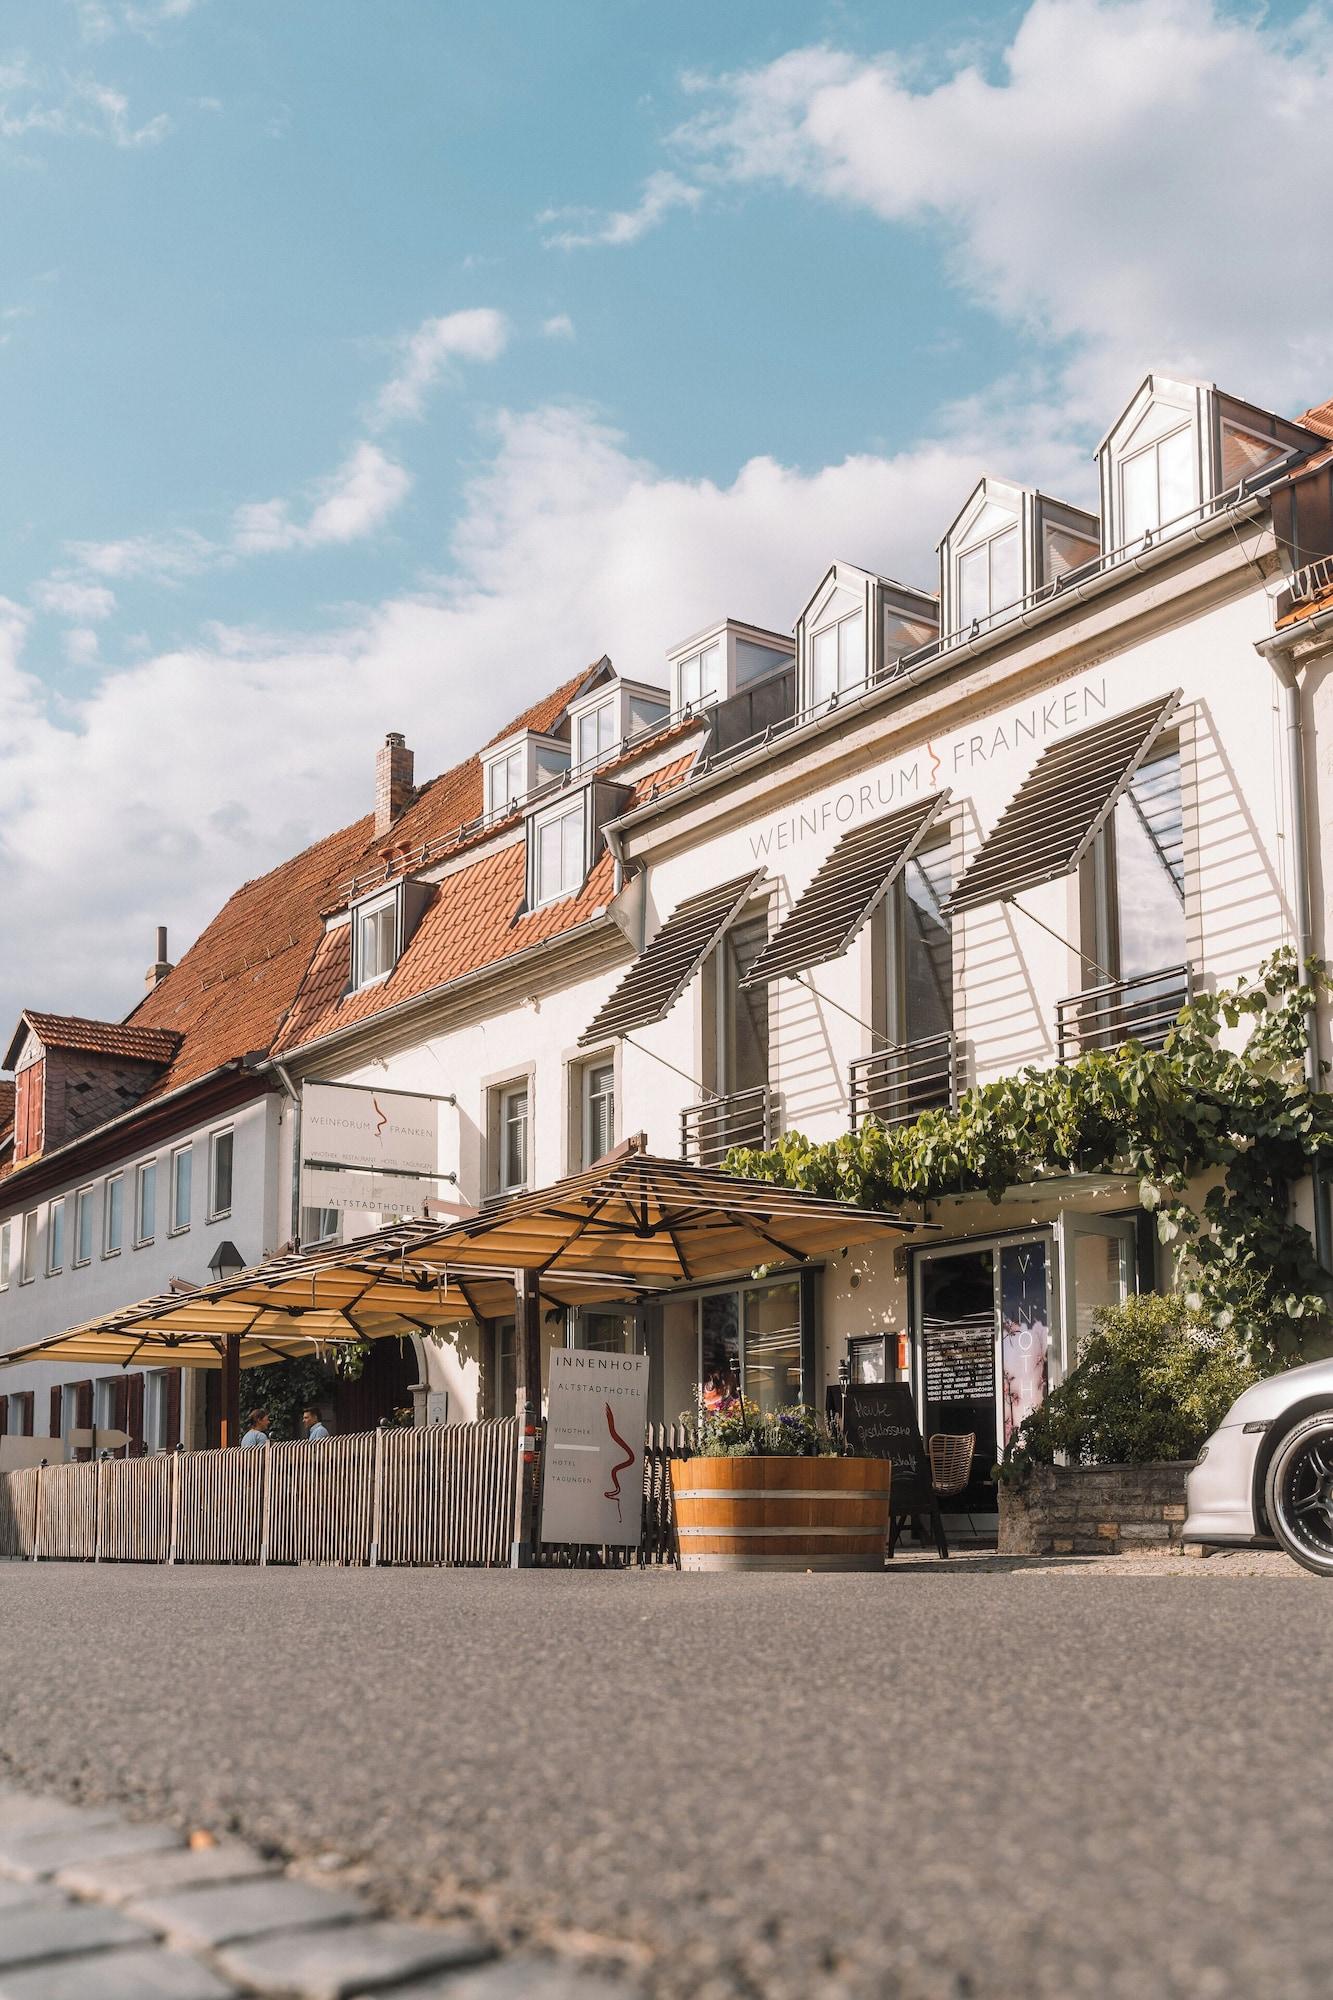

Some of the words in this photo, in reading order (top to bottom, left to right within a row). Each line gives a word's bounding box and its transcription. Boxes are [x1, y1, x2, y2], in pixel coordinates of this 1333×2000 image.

[749, 763, 919, 860] WEINFORUM
[953, 678, 1107, 774] FRANKEN
[310, 1116, 370, 1130] WEINFORUM
[389, 1125, 433, 1137] FRANKEN
[328, 1198, 416, 1212] ALTSTADTHOTEL
[556, 1356, 643, 1371] INNENHOF
[558, 1383, 641, 1396] ALTSTADTHOTEL
[552, 1475, 591, 1483] TAGUNGEN
